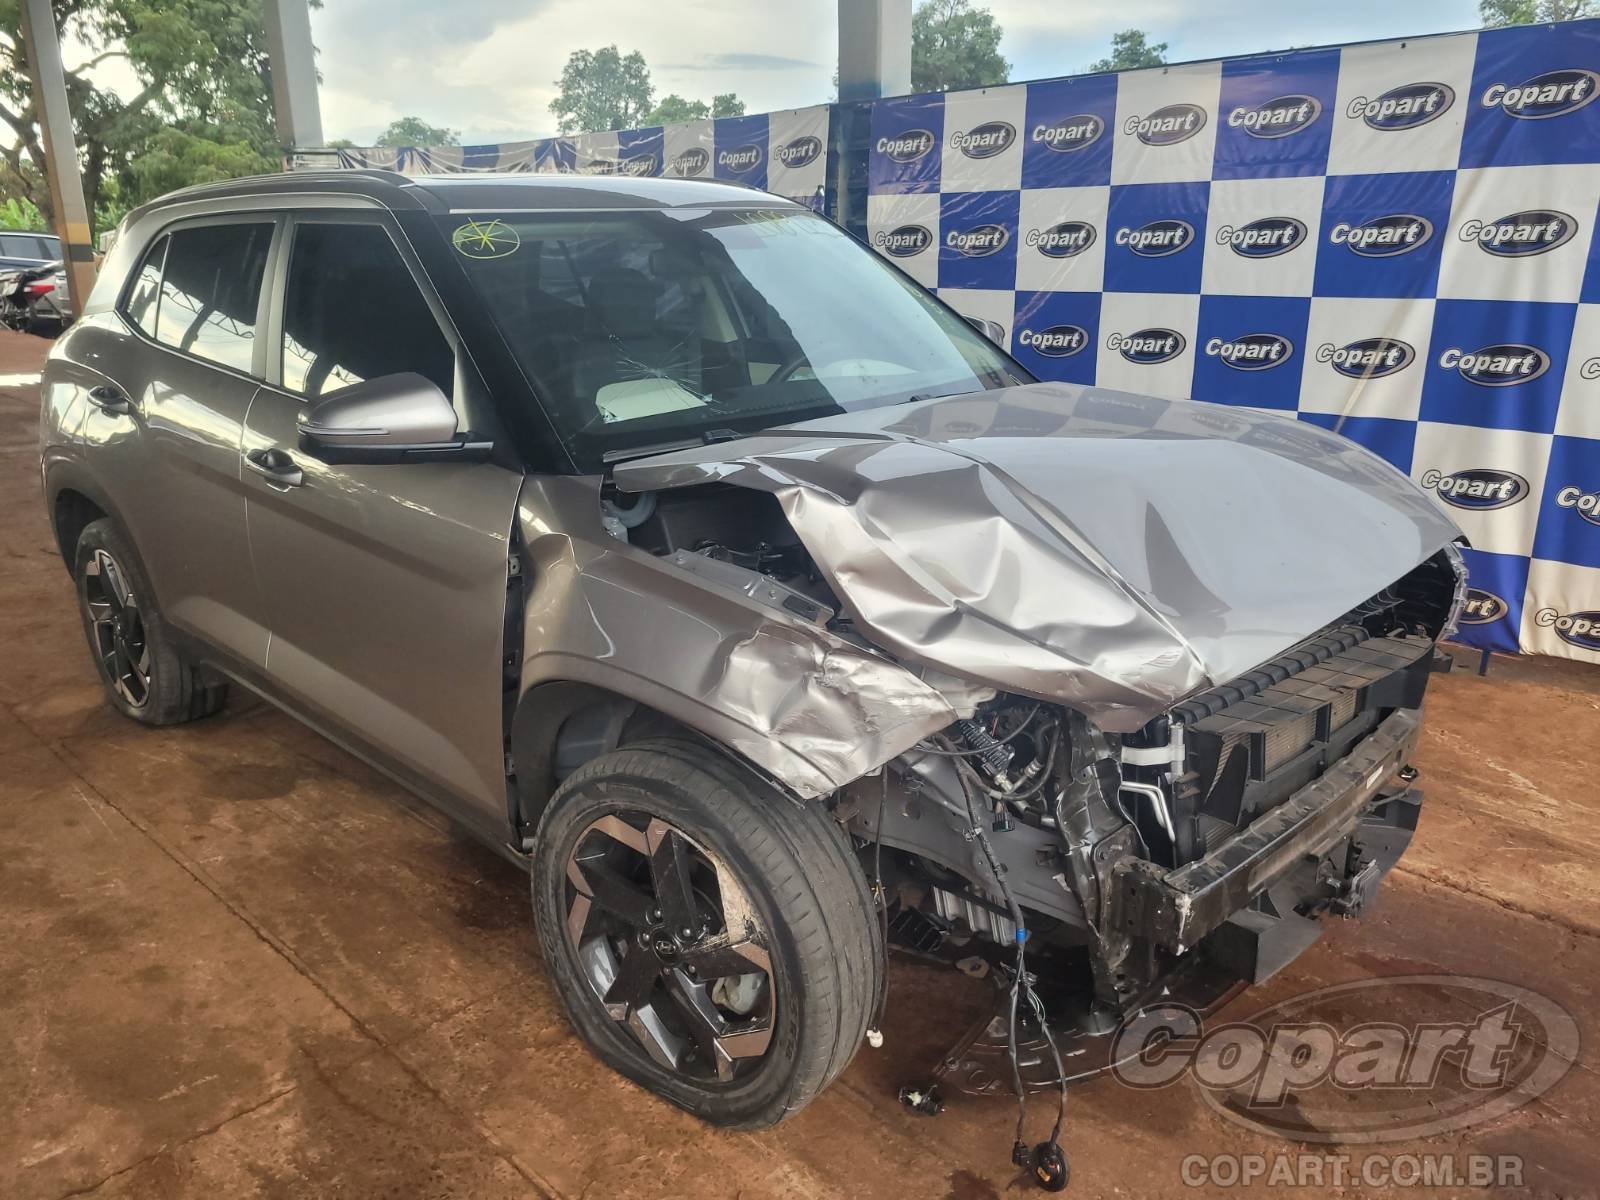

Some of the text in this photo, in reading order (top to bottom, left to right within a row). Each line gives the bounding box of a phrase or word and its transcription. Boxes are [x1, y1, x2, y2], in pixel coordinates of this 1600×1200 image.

[1481, 78, 1589, 110] Copart
[1228, 103, 1310, 128] Copart
[1346, 91, 1441, 122] Copart
[1032, 120, 1095, 145] Copart
[1124, 110, 1196, 137] Copart
[774, 142, 815, 161] Copart
[876, 137, 928, 155] Copart
[950, 129, 1006, 150] Copart
[719, 148, 756, 165] Copart
[875, 230, 924, 249] Copart
[946, 230, 1003, 249] Copart
[1026, 228, 1089, 250] Copart
[1115, 225, 1187, 249] Copart
[1215, 223, 1297, 249] Copart
[1329, 219, 1423, 247] Copart
[1458, 218, 1562, 246] Copart
[1019, 329, 1081, 349] Copart
[1106, 332, 1176, 354] Copart
[1205, 338, 1283, 360] Copart
[1315, 343, 1401, 368] Copart
[1439, 348, 1538, 378] Copart
[1421, 469, 1516, 500] Copart
